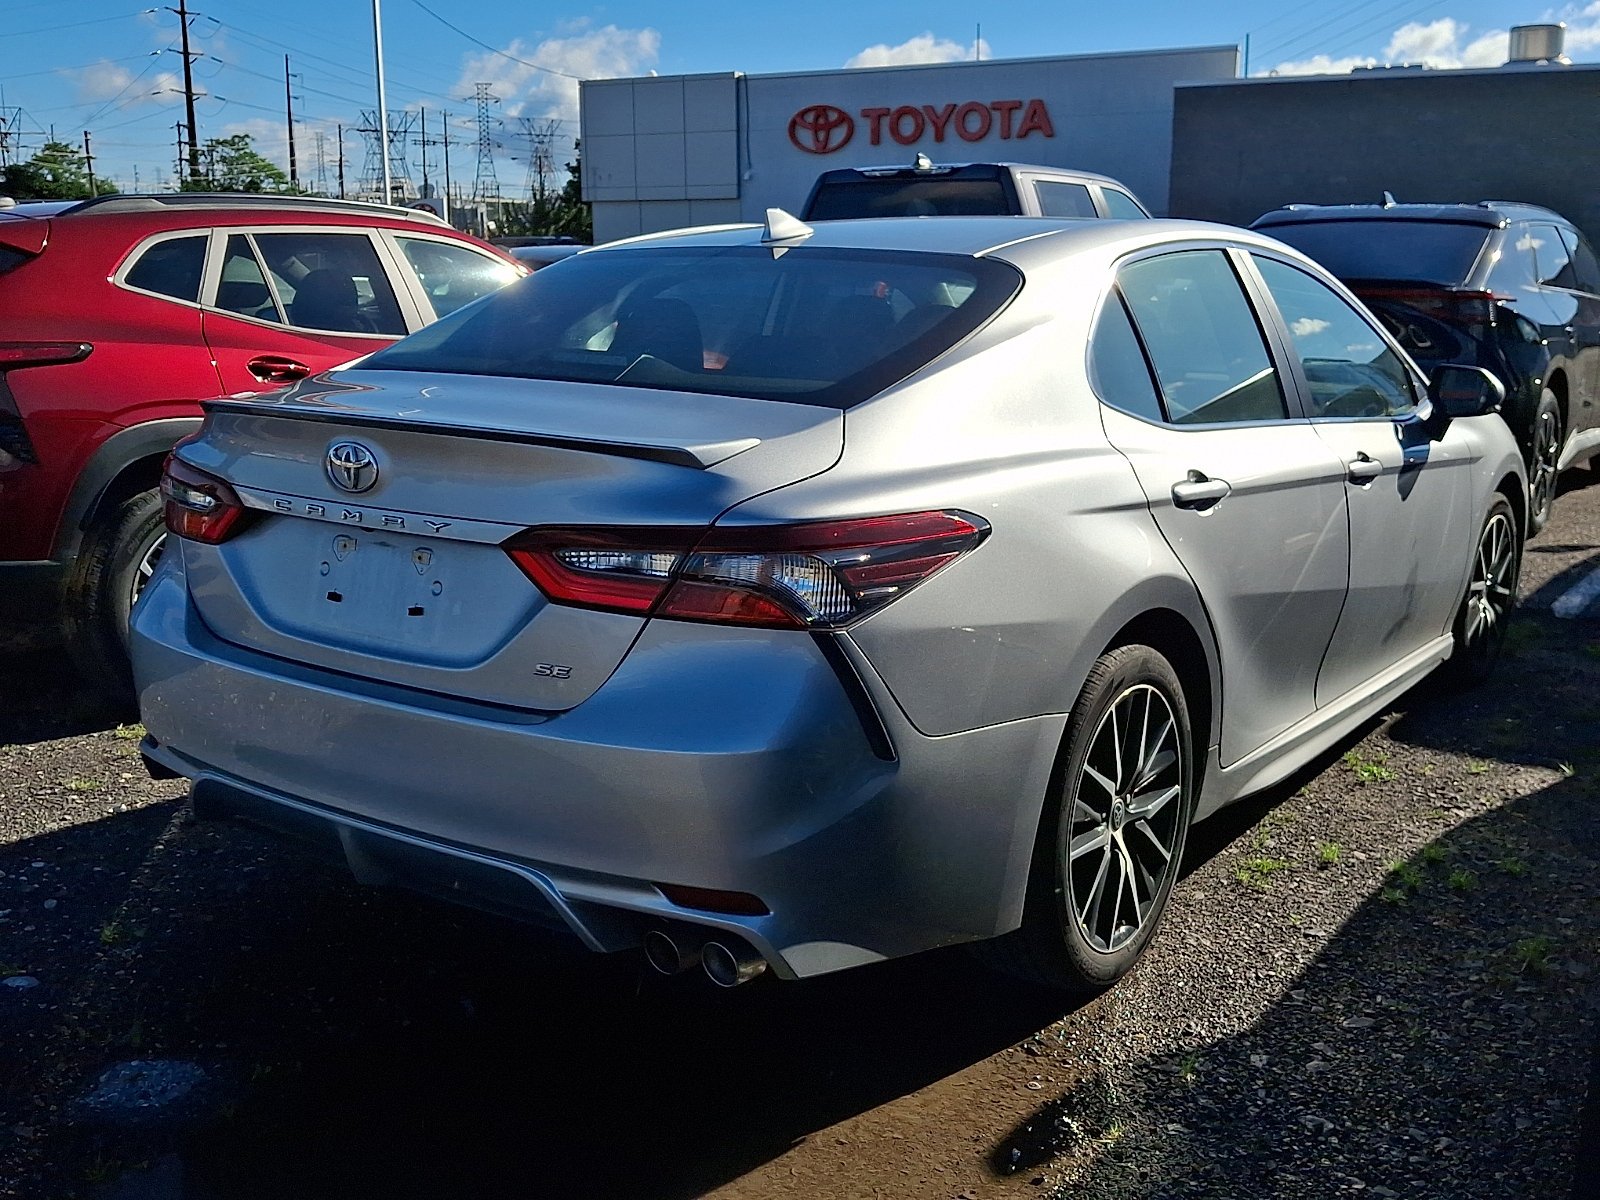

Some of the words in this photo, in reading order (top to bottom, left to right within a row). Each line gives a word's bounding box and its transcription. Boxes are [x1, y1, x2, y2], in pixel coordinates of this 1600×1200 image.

[861, 99, 1054, 145] TOYOTA
[273, 499, 451, 533] CAMRY
[533, 662, 572, 679] SE
